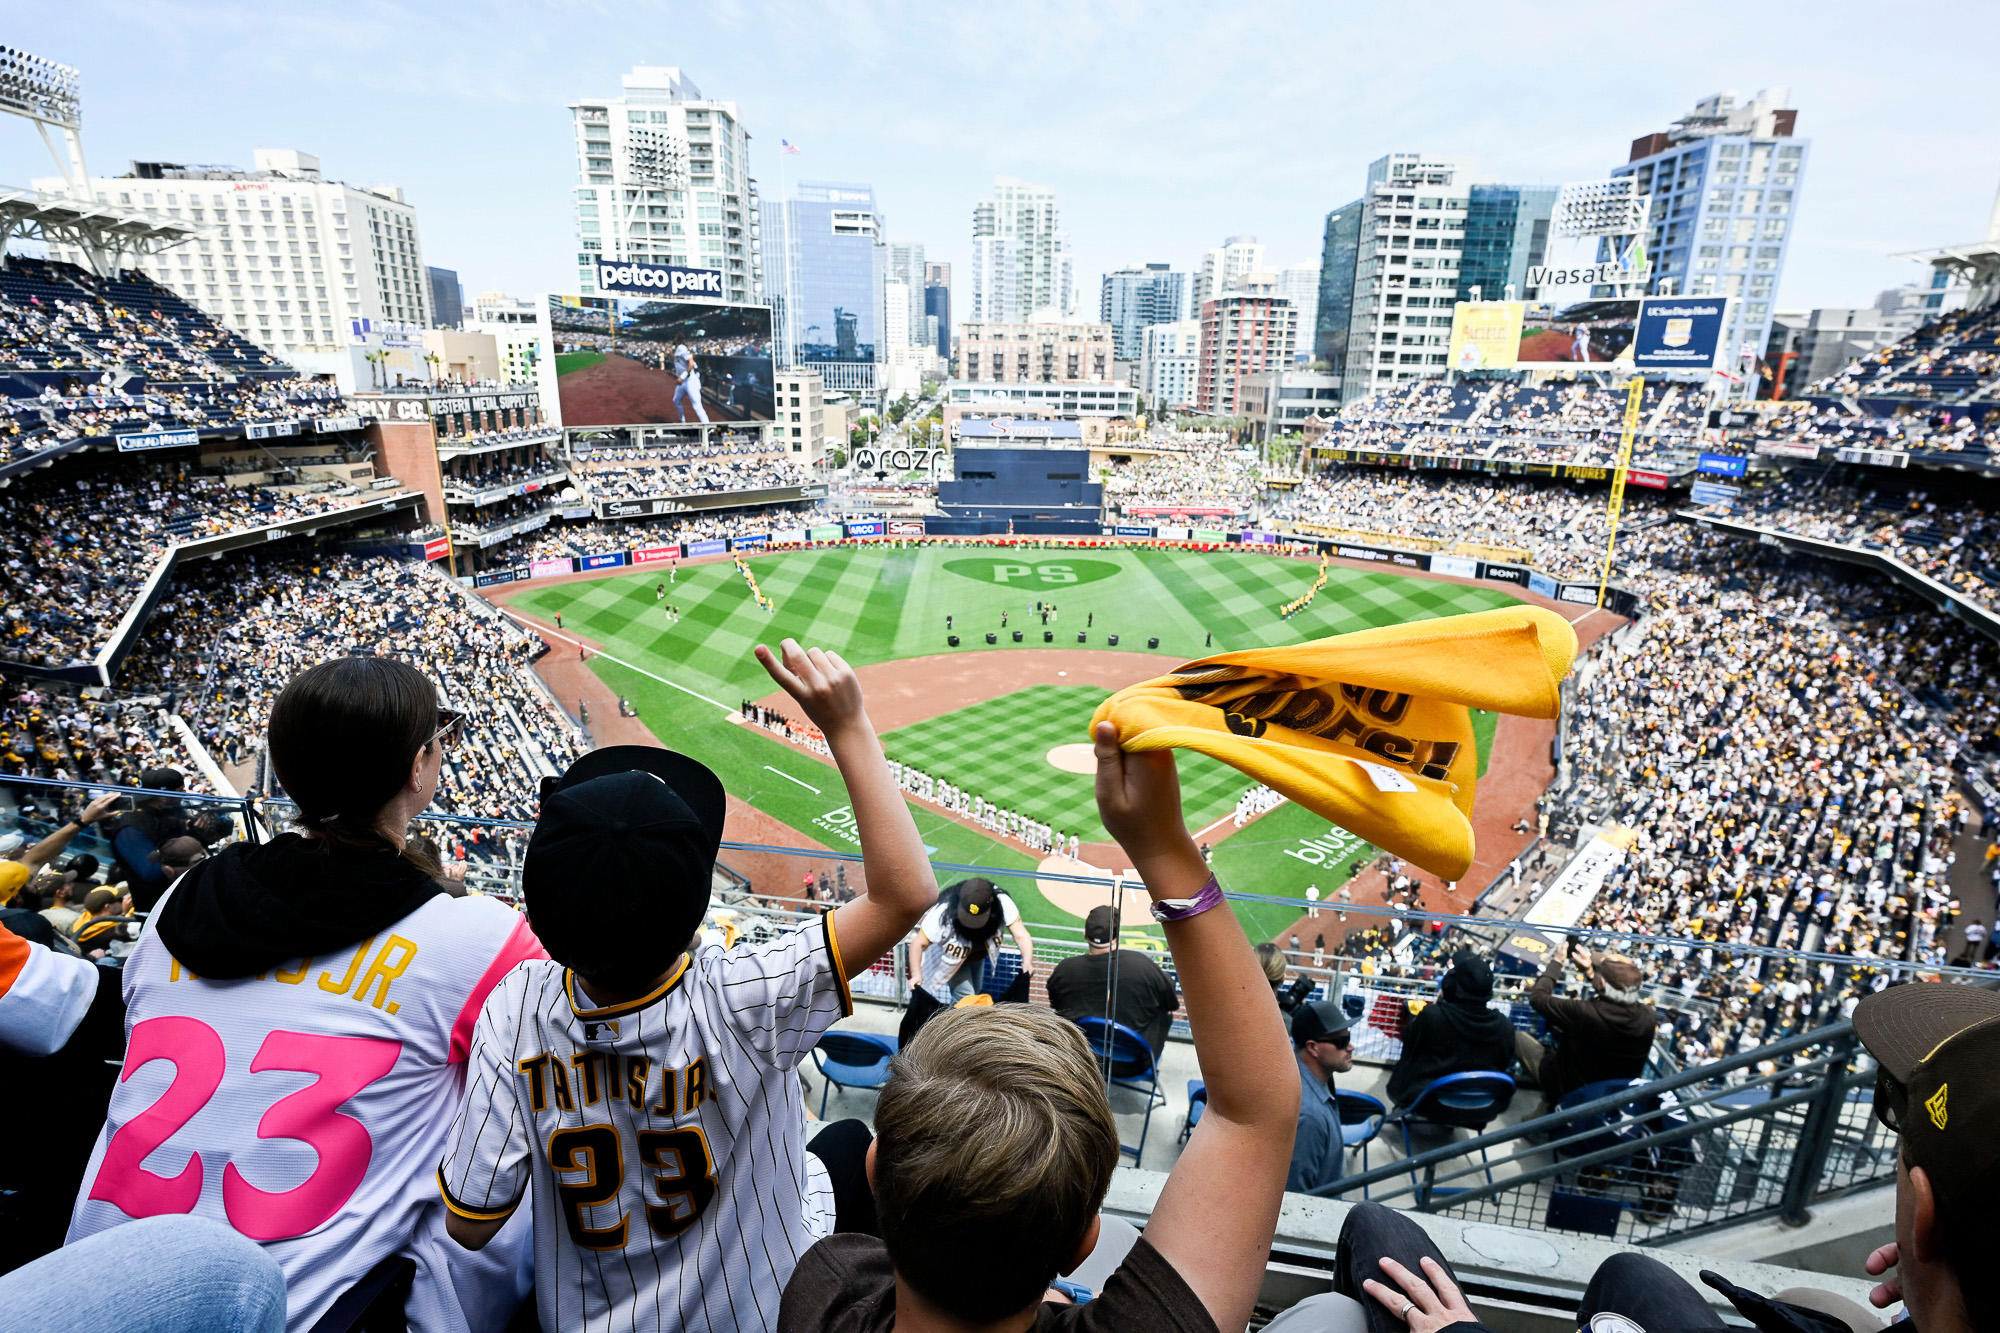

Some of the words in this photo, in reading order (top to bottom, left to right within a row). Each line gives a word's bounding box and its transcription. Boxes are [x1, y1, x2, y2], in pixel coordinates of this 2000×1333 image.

[600, 263, 669, 289] petco
[670, 270, 721, 294] park
[1533, 264, 1608, 285] Viasat
[397, 401, 429, 421] CO.
[428, 397, 471, 415] WESTERN
[472, 396, 499, 412] METAL
[499, 395, 526, 409] SUPPLY
[880, 450, 946, 471] razr
[1564, 465, 1607, 480] PADRES
[851, 525, 874, 535] ARCO
[515, 569, 529, 580] 342
[1489, 568, 1520, 580] SONY
[1283, 826, 1358, 865] blue
[317, 933, 418, 1016] JR.
[518, 1050, 652, 1113] TATIS
[653, 1055, 719, 1117] JR.
[87, 1015, 403, 1241] 23
[547, 1122, 719, 1251] 23
